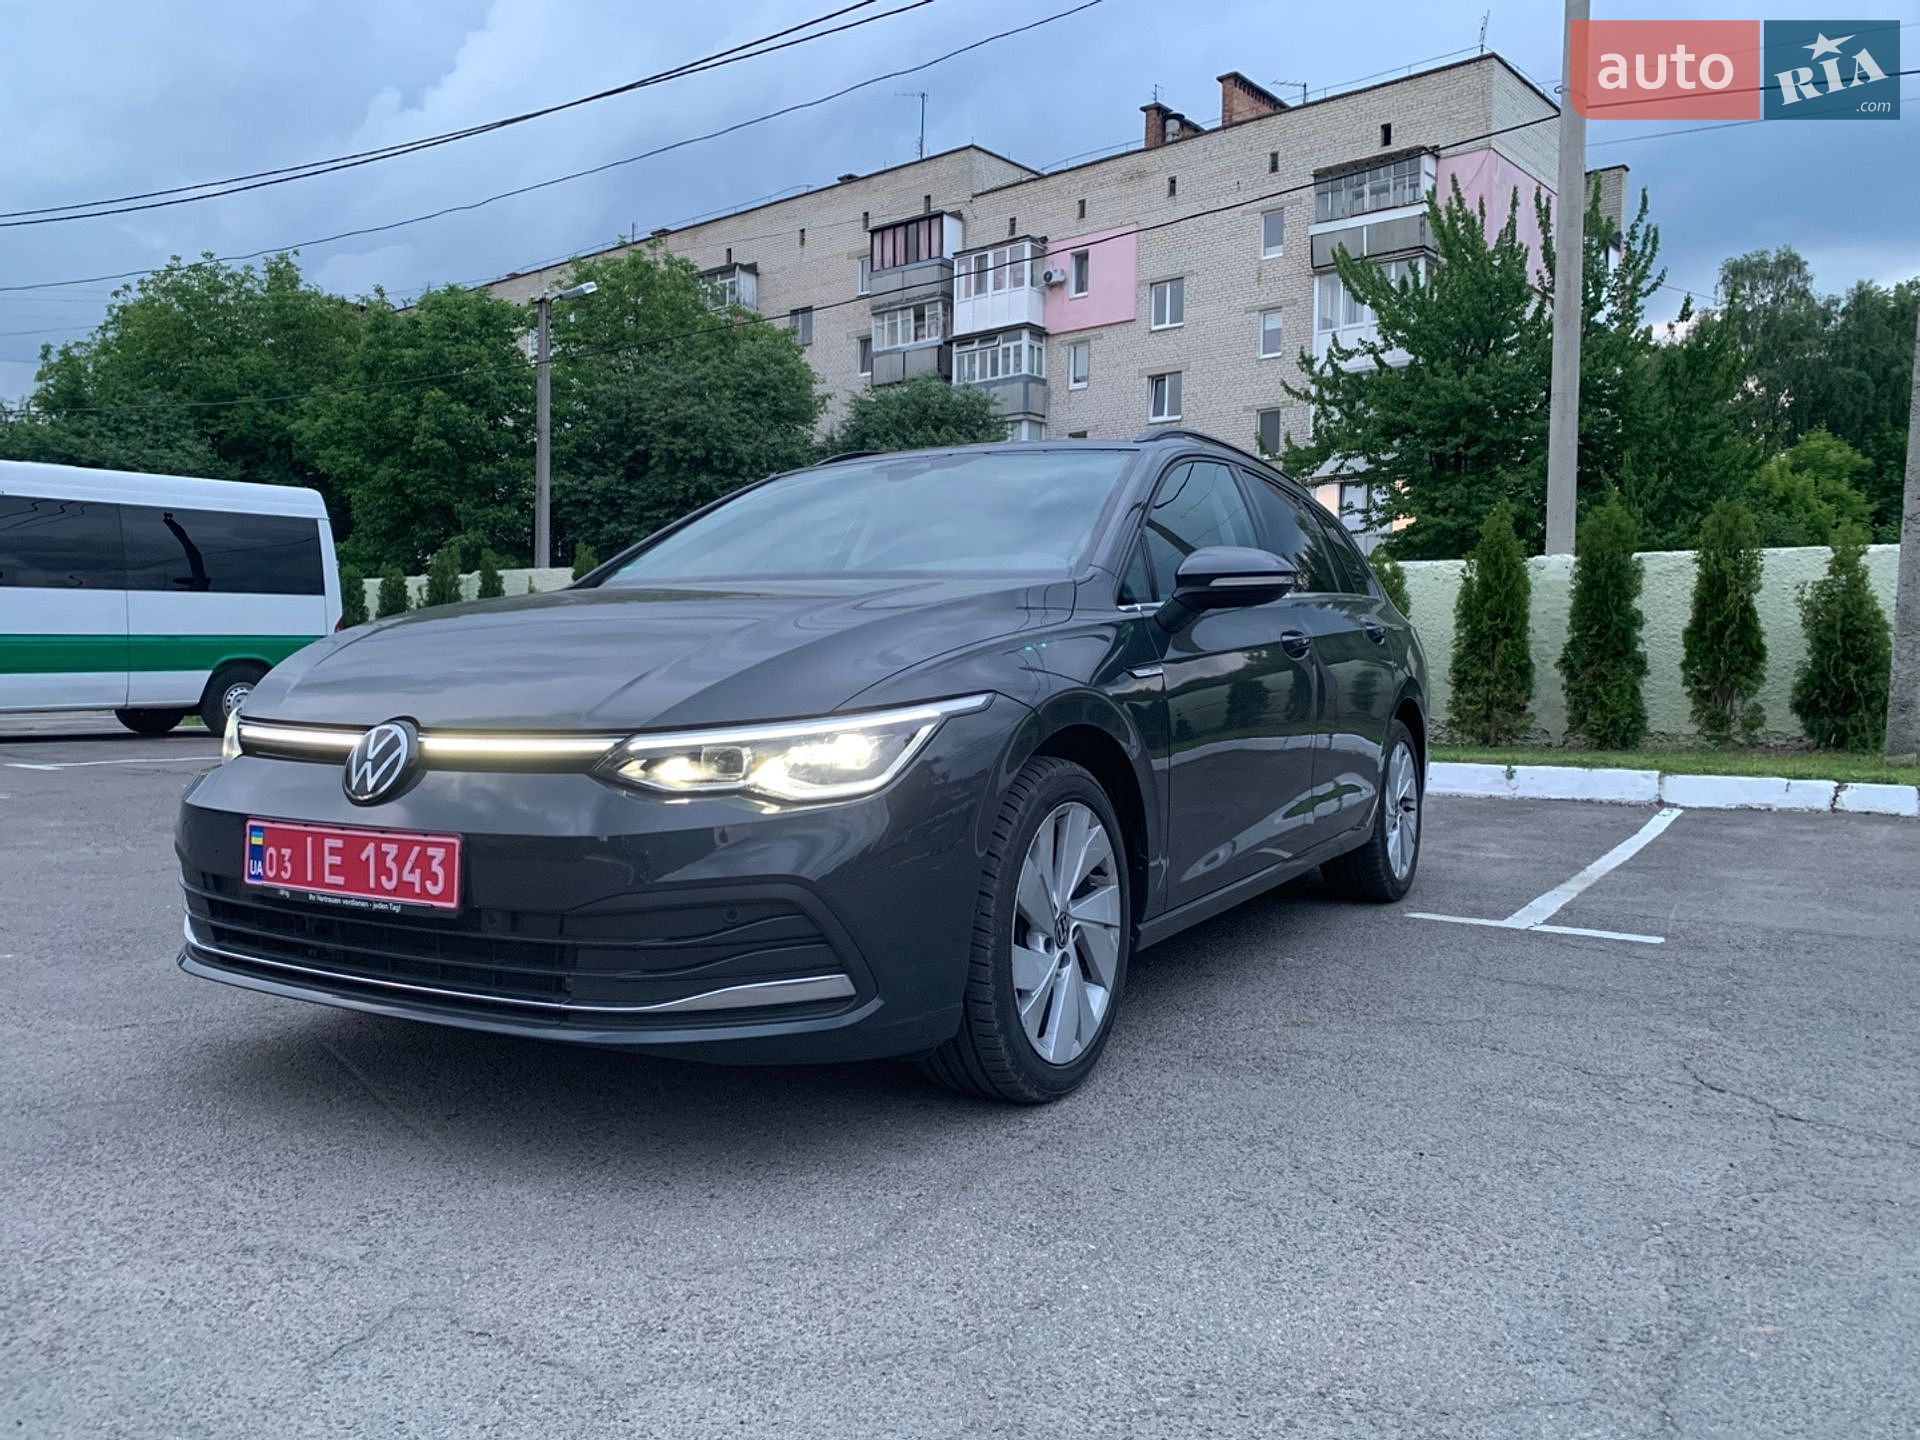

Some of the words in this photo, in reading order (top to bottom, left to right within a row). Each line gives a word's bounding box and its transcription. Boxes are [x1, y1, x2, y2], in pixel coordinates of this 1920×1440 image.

[249, 858, 264, 876] UA
[265, 847, 292, 880] 03
[306, 836, 345, 885] IE
[360, 842, 446, 895] 1343
